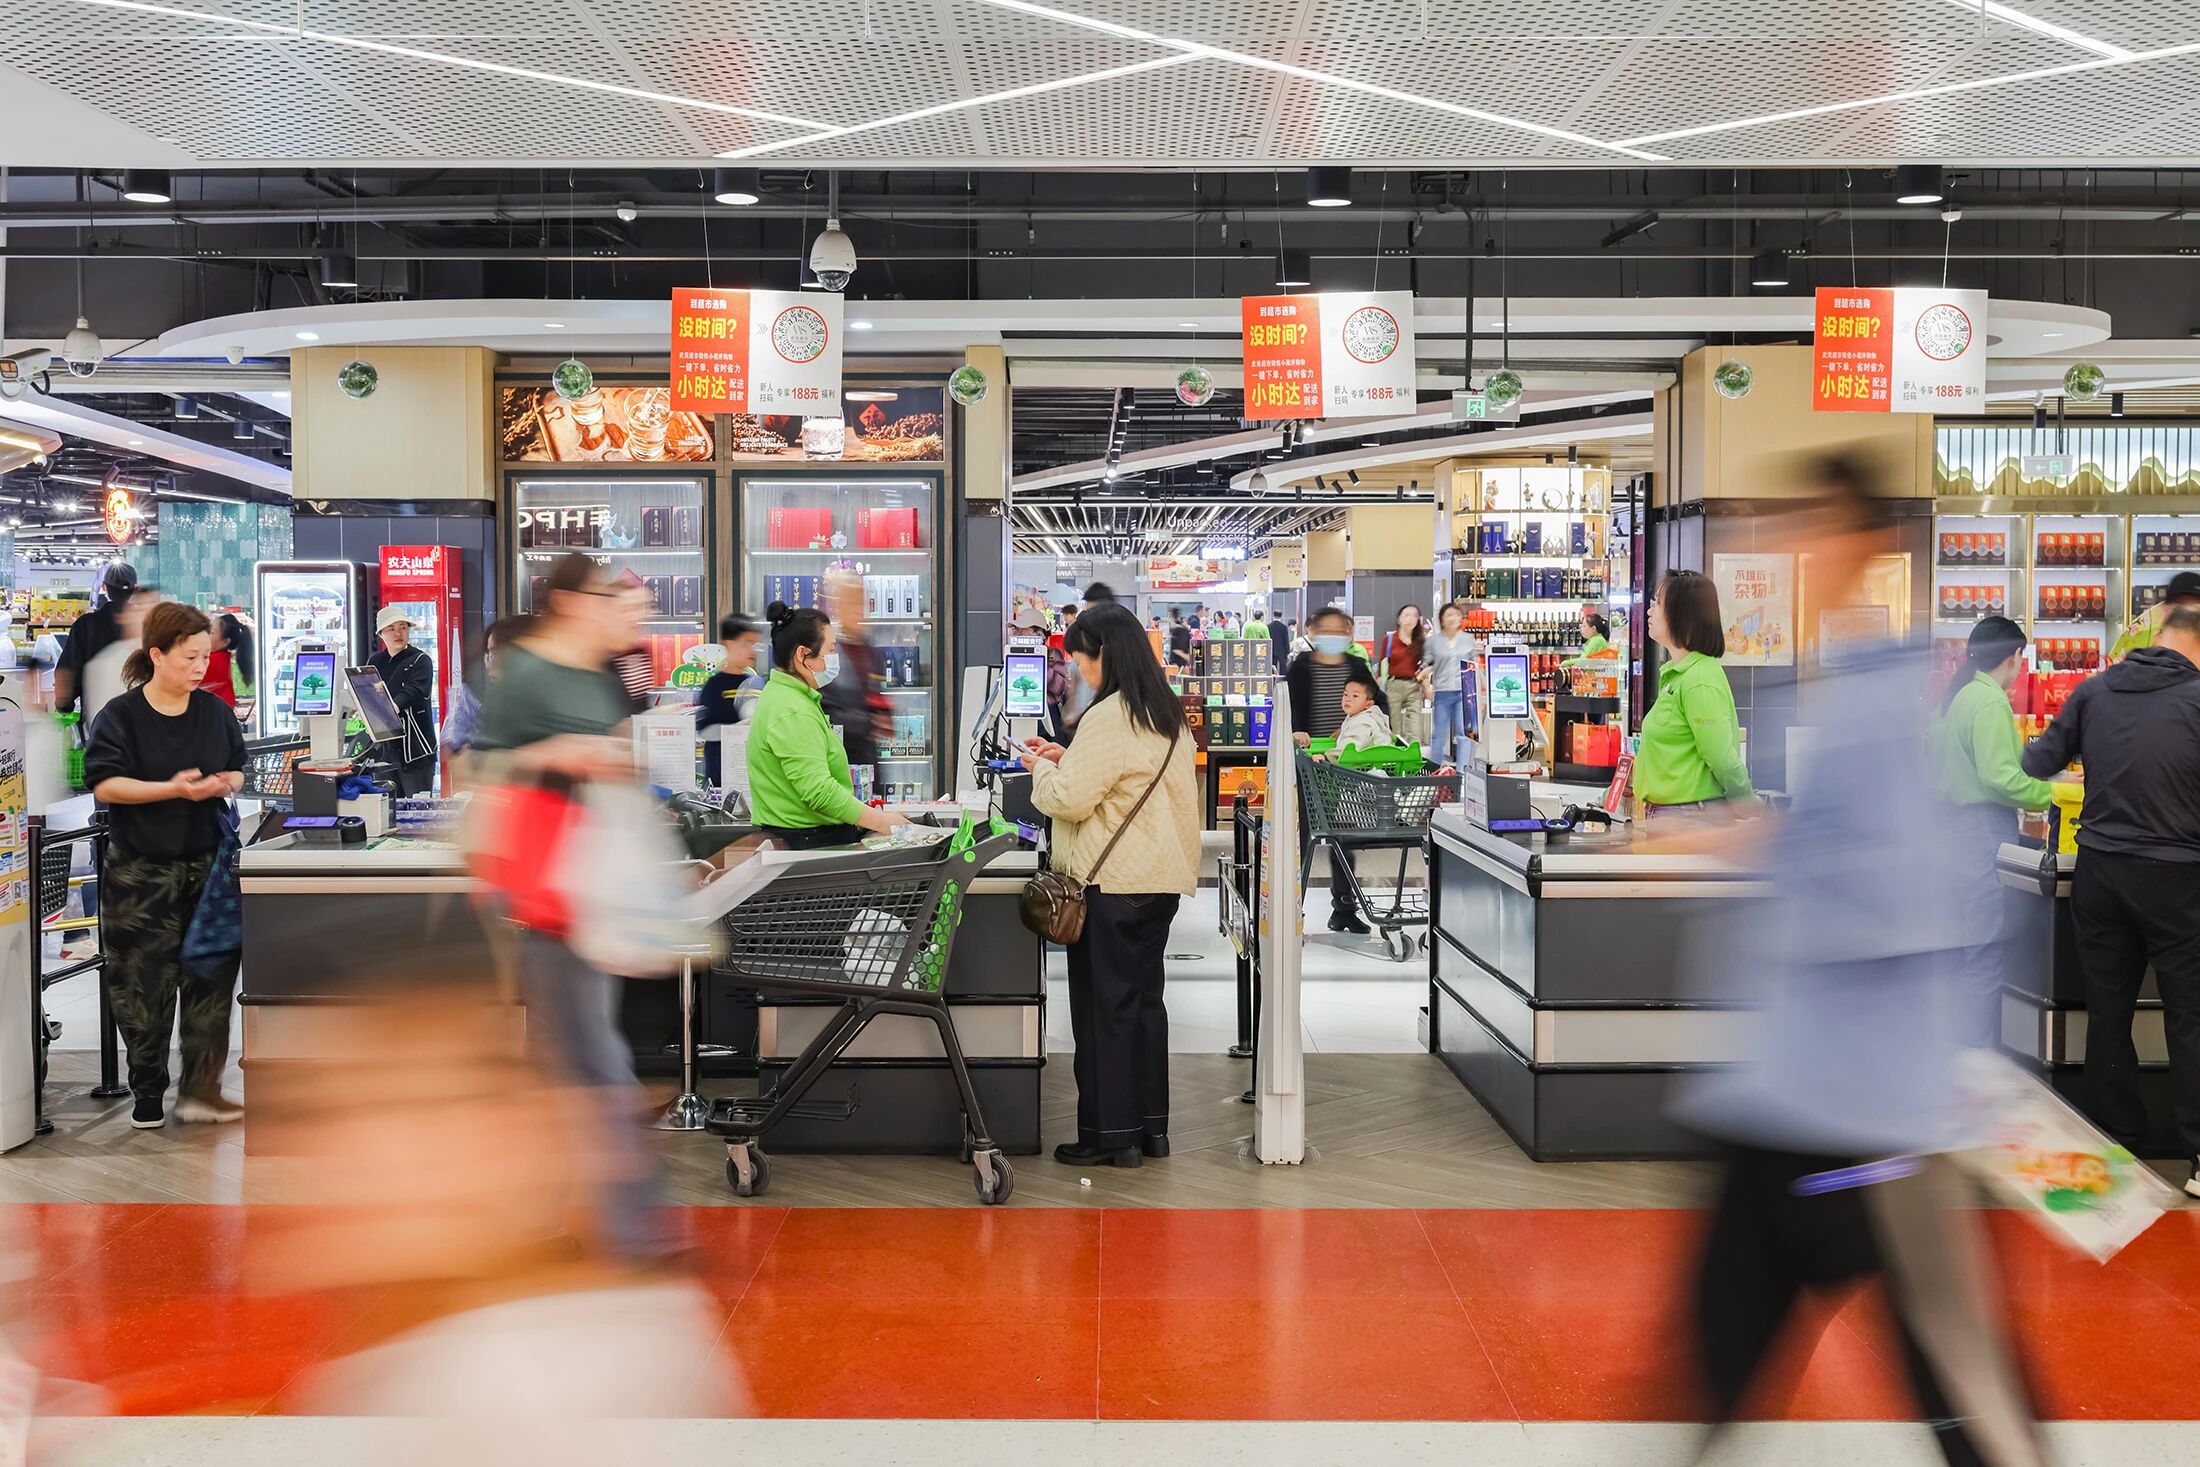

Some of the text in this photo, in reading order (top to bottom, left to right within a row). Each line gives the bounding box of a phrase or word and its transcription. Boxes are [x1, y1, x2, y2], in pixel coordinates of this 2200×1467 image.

[1834, 298, 1870, 309] 到超市选购
[1259, 306, 1297, 317] 到超市选购
[677, 374, 726, 400] 小时达
[729, 378, 744, 390] 配送
[760, 383, 773, 392] 新人
[1820, 374, 1870, 399] 小时达
[1872, 376, 1887, 388] 配送
[1903, 380, 1917, 390] 新人
[777, 388, 835, 400] 专享 188元 福利
[1303, 383, 1318, 394] 配送
[1334, 385, 1348, 395] 新人
[1351, 387, 1410, 400] 专享 188元 福利
[1920, 385, 1979, 398] 专享 188元 福利
[729, 390, 744, 401] 到家
[760, 393, 773, 403] 扫码
[1251, 382, 1300, 407] 小时达
[1872, 389, 1887, 401] 到家
[1903, 391, 1917, 401] 扫码
[1303, 395, 1319, 406] 到家
[1334, 396, 1348, 405] 扫码
[1167, 516, 1228, 530] Unpacked
[1206, 534, 1247, 542] snacks
[387, 556, 434, 569] 农夫山泉
[1735, 583, 1767, 599] 杂物
